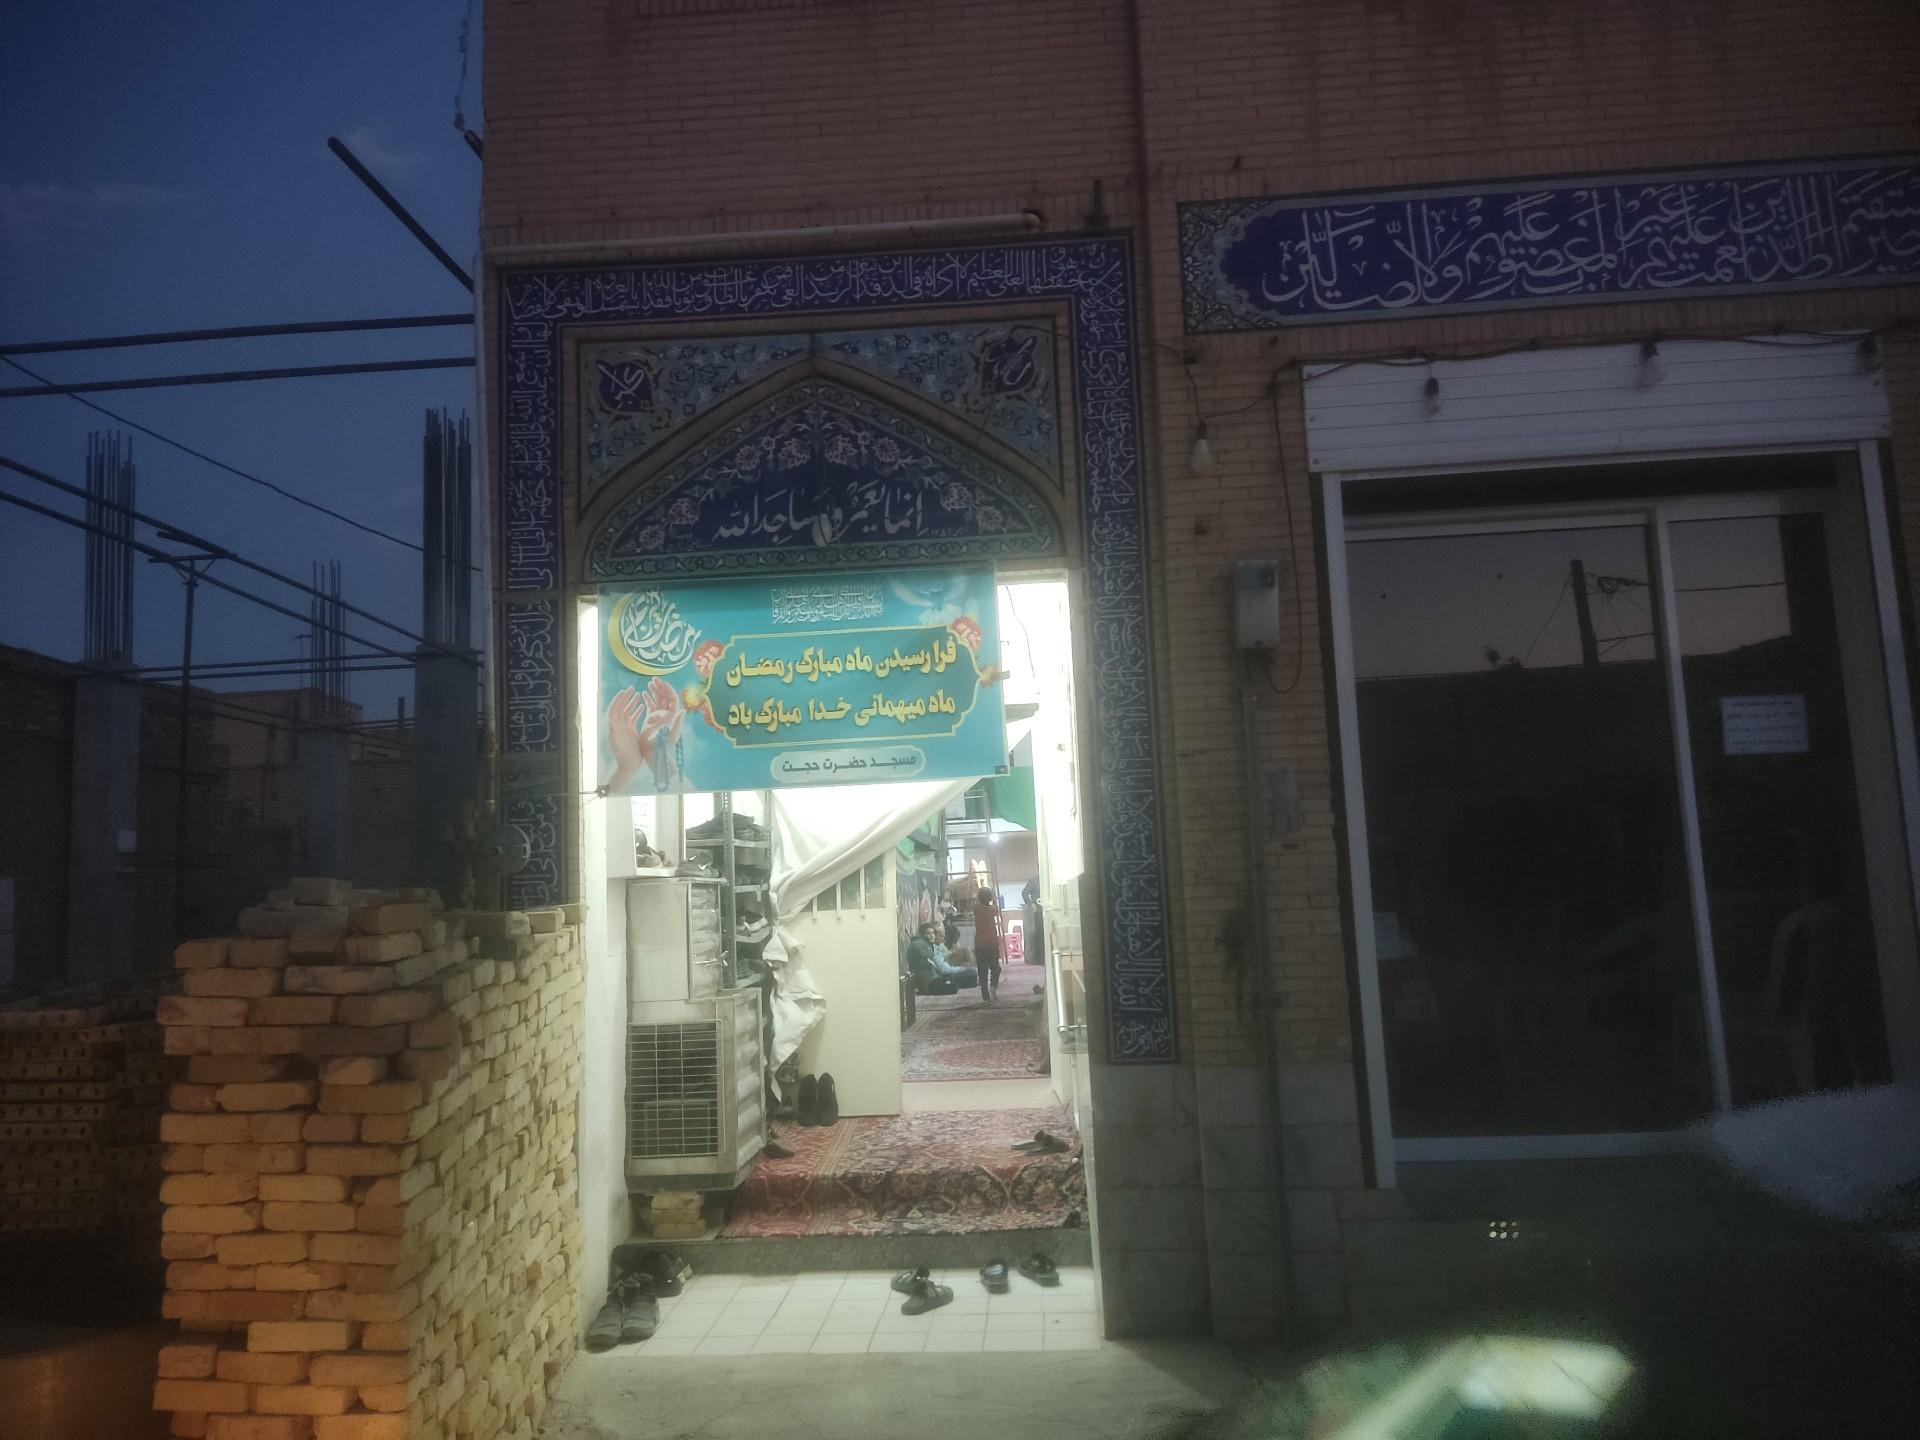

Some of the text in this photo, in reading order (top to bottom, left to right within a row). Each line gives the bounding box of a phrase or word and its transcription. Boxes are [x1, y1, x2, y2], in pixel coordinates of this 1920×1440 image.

[726, 652, 794, 687] رمضان
[795, 646, 843, 682] مبارک
[845, 646, 873, 672] ماه
[728, 689, 956, 732] ماه میهمانی خدا مبارک باد
[782, 755, 917, 777] مسجد حضرت حجت
